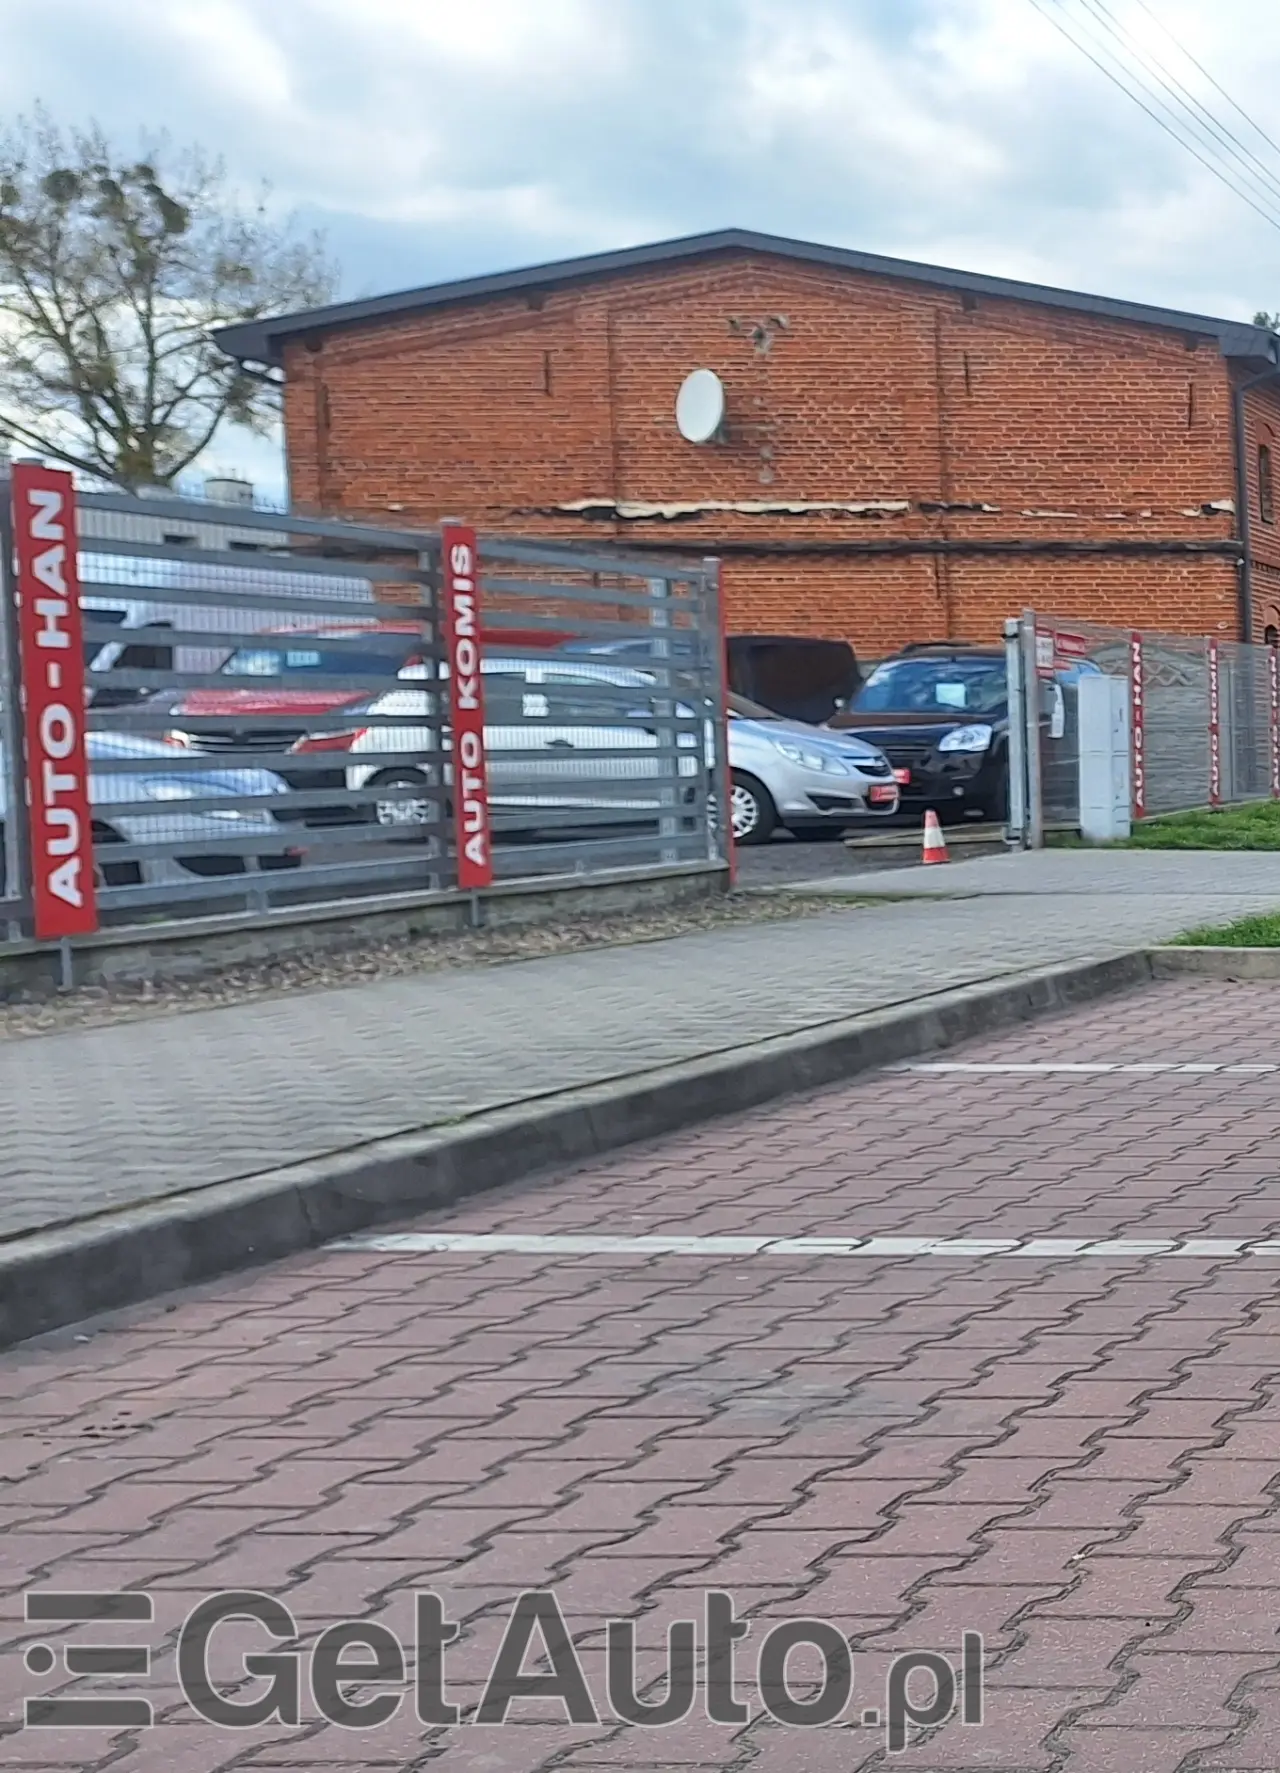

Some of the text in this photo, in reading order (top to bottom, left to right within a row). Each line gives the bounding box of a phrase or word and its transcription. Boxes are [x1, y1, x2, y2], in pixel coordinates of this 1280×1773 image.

[28, 488, 71, 649] HAN
[451, 543, 486, 866] AUTO KOMIS
[1132, 641, 1142, 706] HAN
[39, 703, 84, 908] AUTO
[1133, 726, 1144, 807] AUTO
